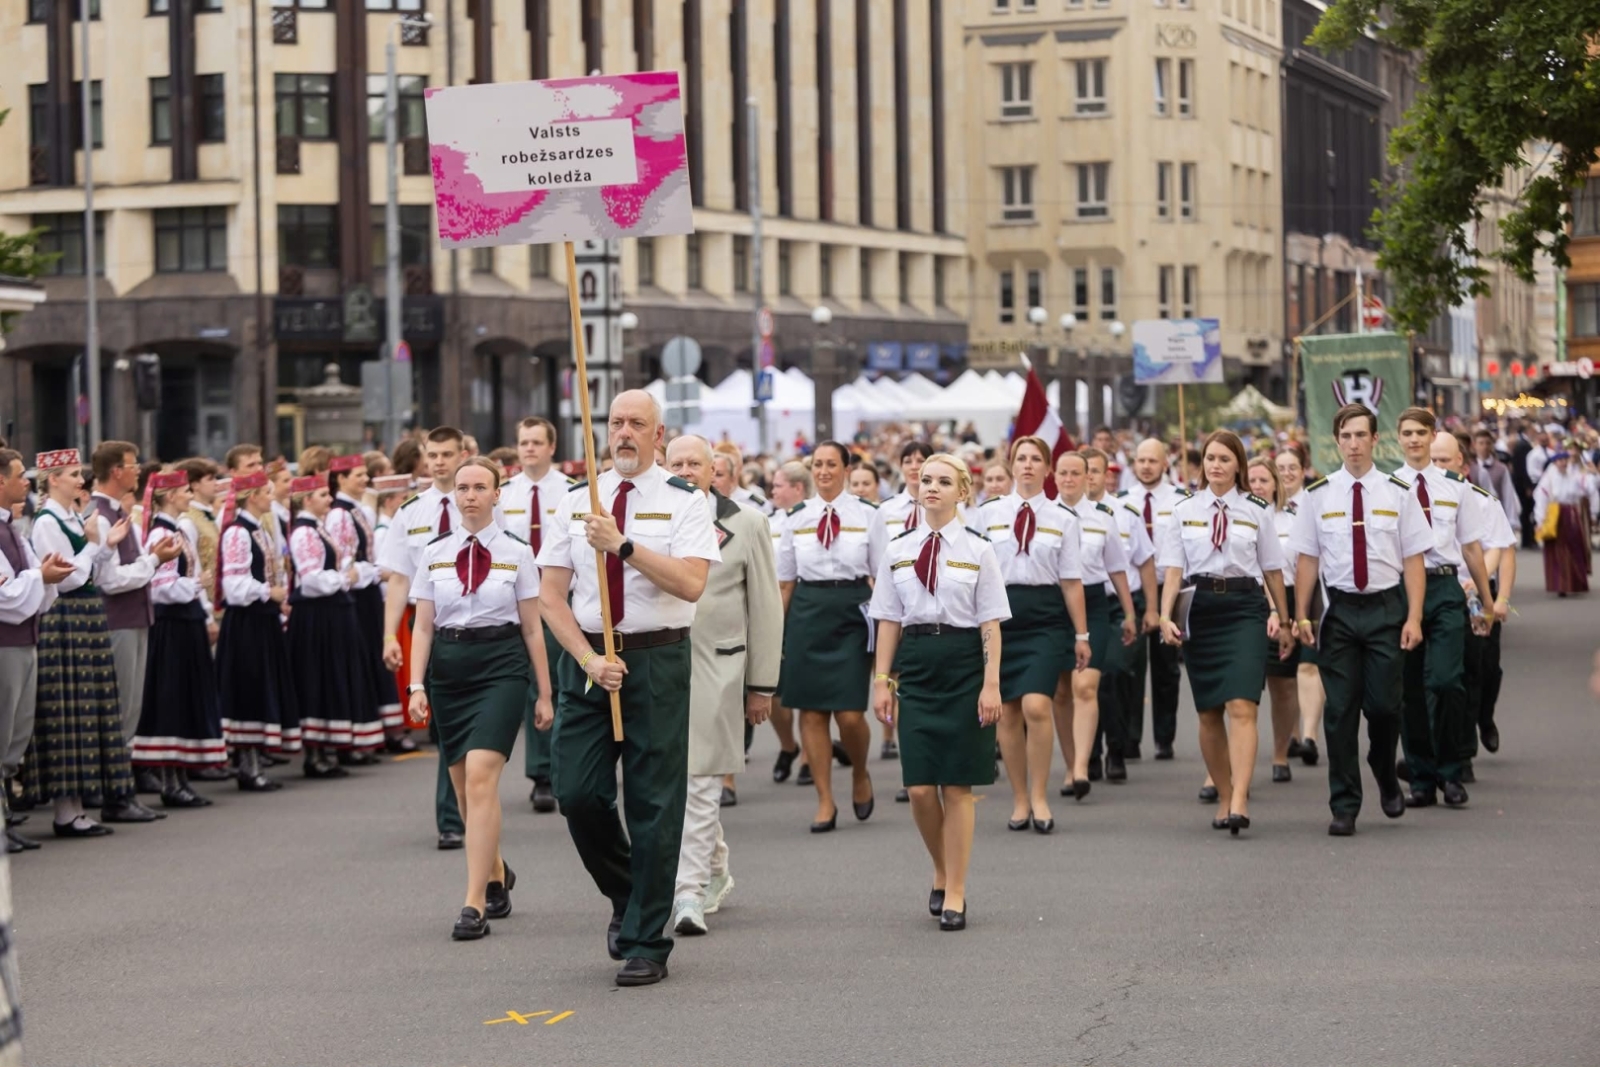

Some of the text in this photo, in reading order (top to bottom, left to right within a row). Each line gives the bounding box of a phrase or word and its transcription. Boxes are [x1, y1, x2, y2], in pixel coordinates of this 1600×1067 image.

[529, 125, 581, 139] Valsts
[501, 147, 614, 164] robežsardzes
[528, 169, 592, 185] koledža
